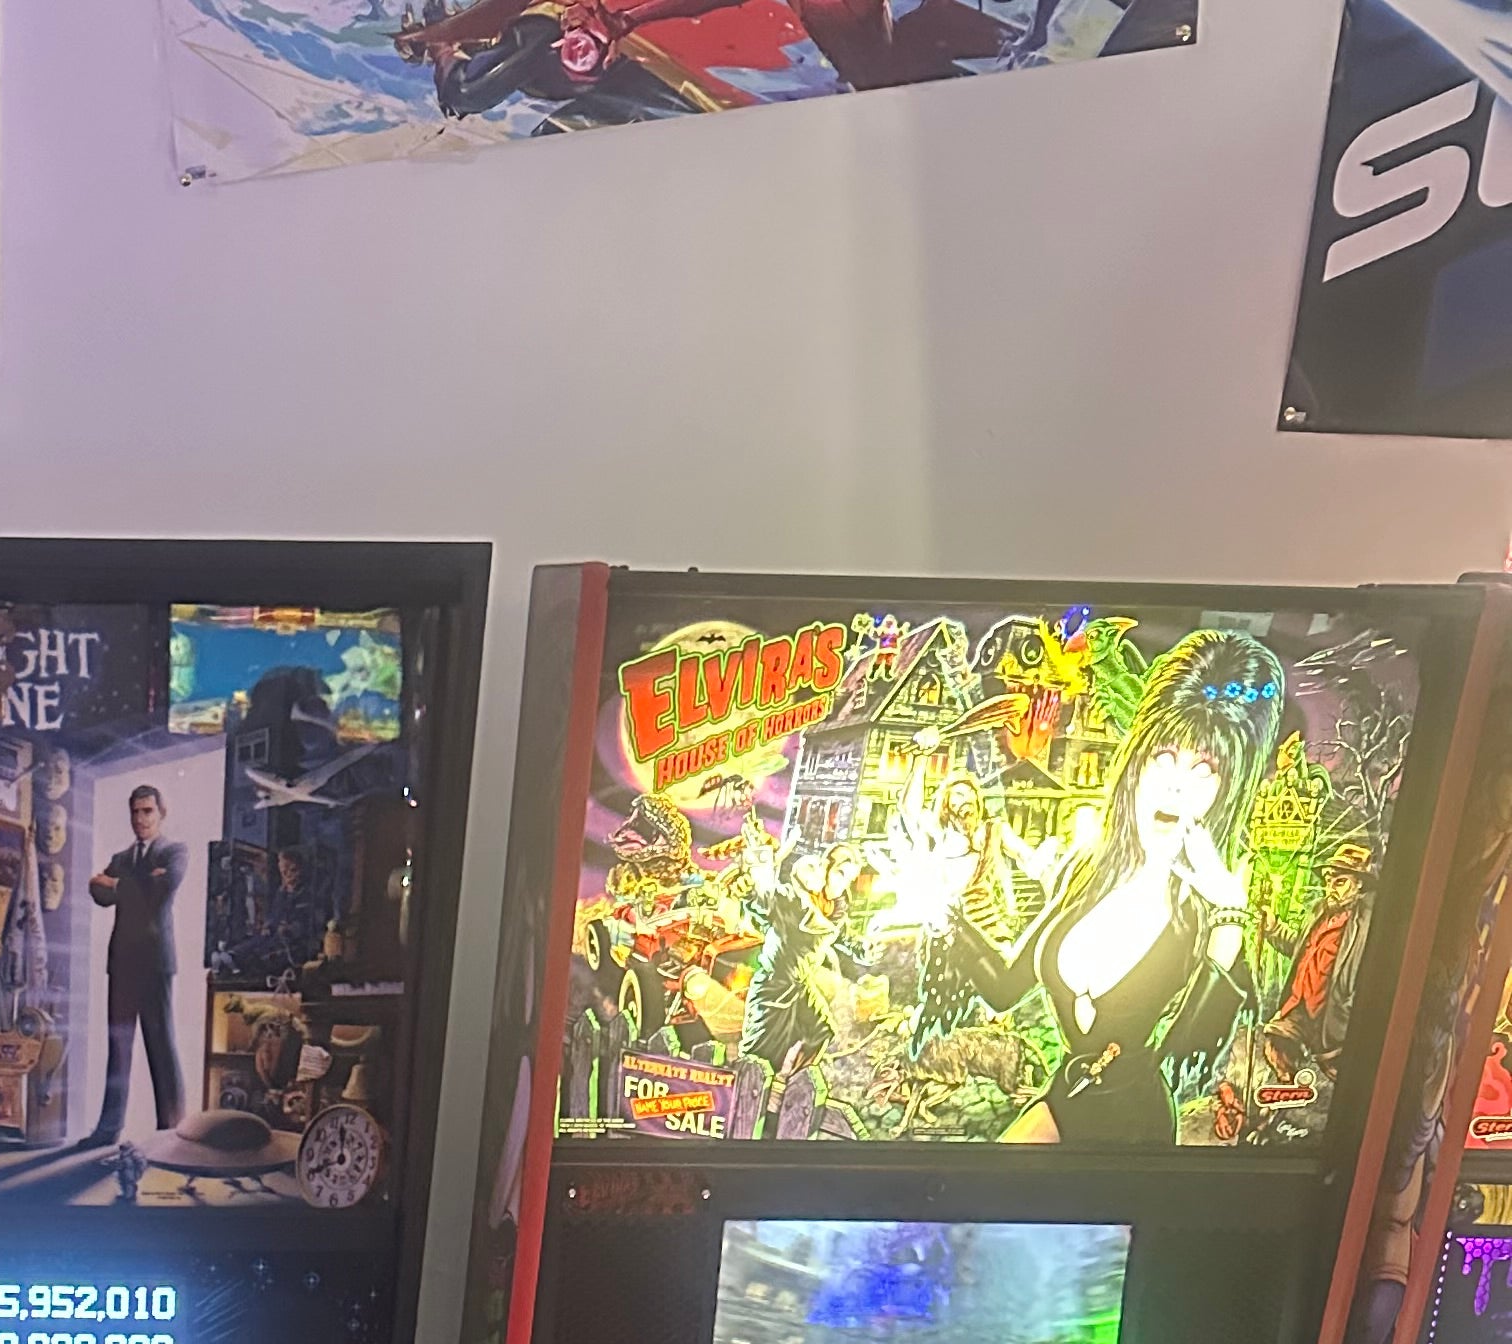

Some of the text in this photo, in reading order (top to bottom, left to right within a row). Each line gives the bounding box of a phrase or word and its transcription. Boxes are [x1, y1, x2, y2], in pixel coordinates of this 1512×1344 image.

[620, 623, 846, 762] ELVIRA'S
[656, 678, 829, 792] HOUSE OF HORRORS
[624, 1075, 670, 1100] FOR
[1262, 1089, 1310, 1102] Stern
[633, 1098, 660, 1114] NAME
[660, 1096, 683, 1112] YOUR
[665, 1112, 726, 1140] SALE
